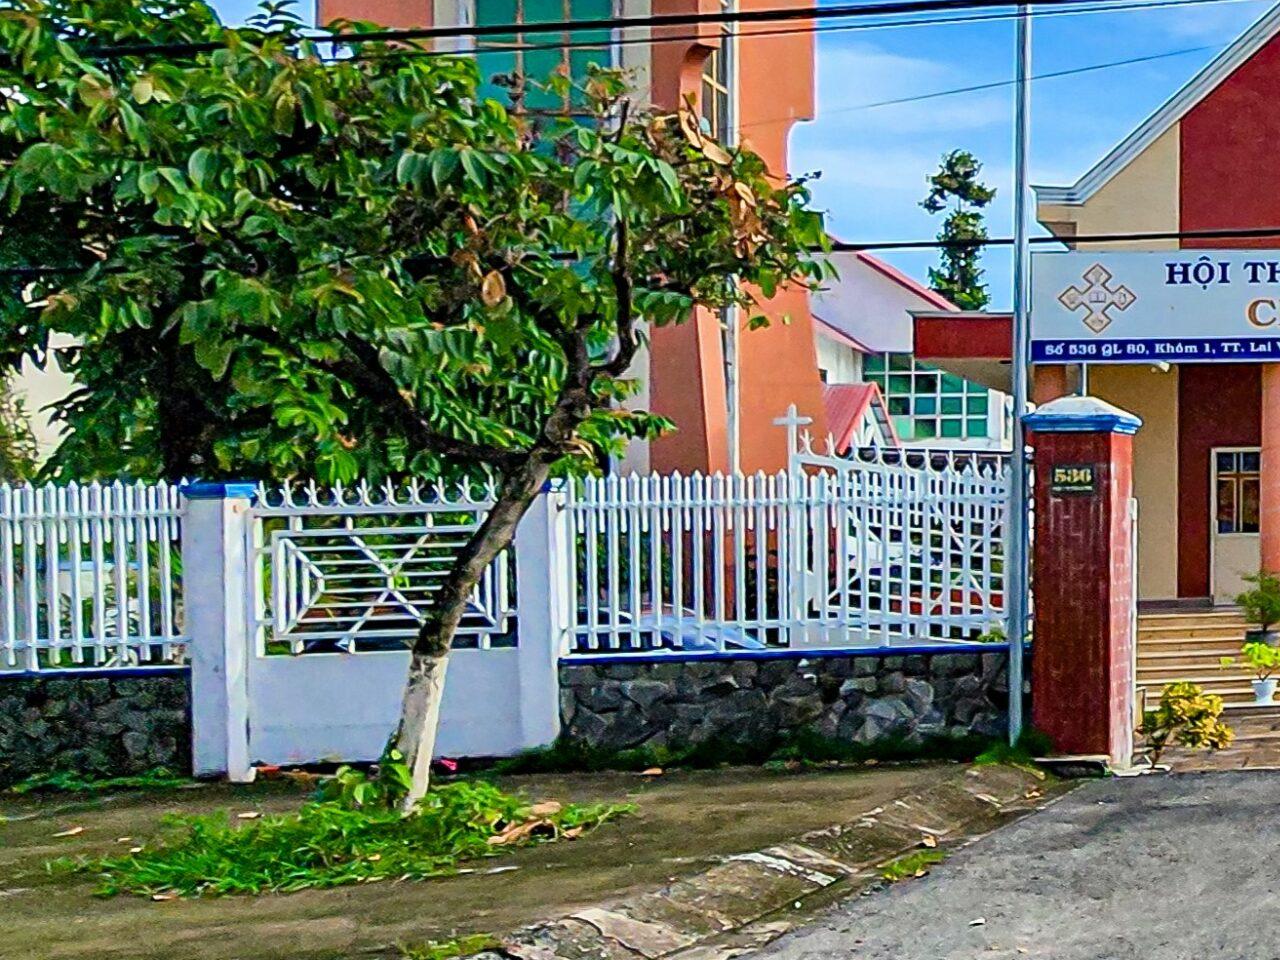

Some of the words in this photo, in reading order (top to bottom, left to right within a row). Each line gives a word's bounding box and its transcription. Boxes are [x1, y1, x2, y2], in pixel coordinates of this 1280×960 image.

[1165, 255, 1231, 290] HỘI
[1045, 342, 1065, 355] Số
[1068, 343, 1097, 355] 536
[1101, 343, 1122, 357] QL
[1126, 343, 1149, 355] 80,
[1204, 343, 1216, 355] 1,
[1221, 342, 1245, 353] TT.
[1250, 341, 1272, 352] Lai
[1054, 468, 1092, 482] 536
